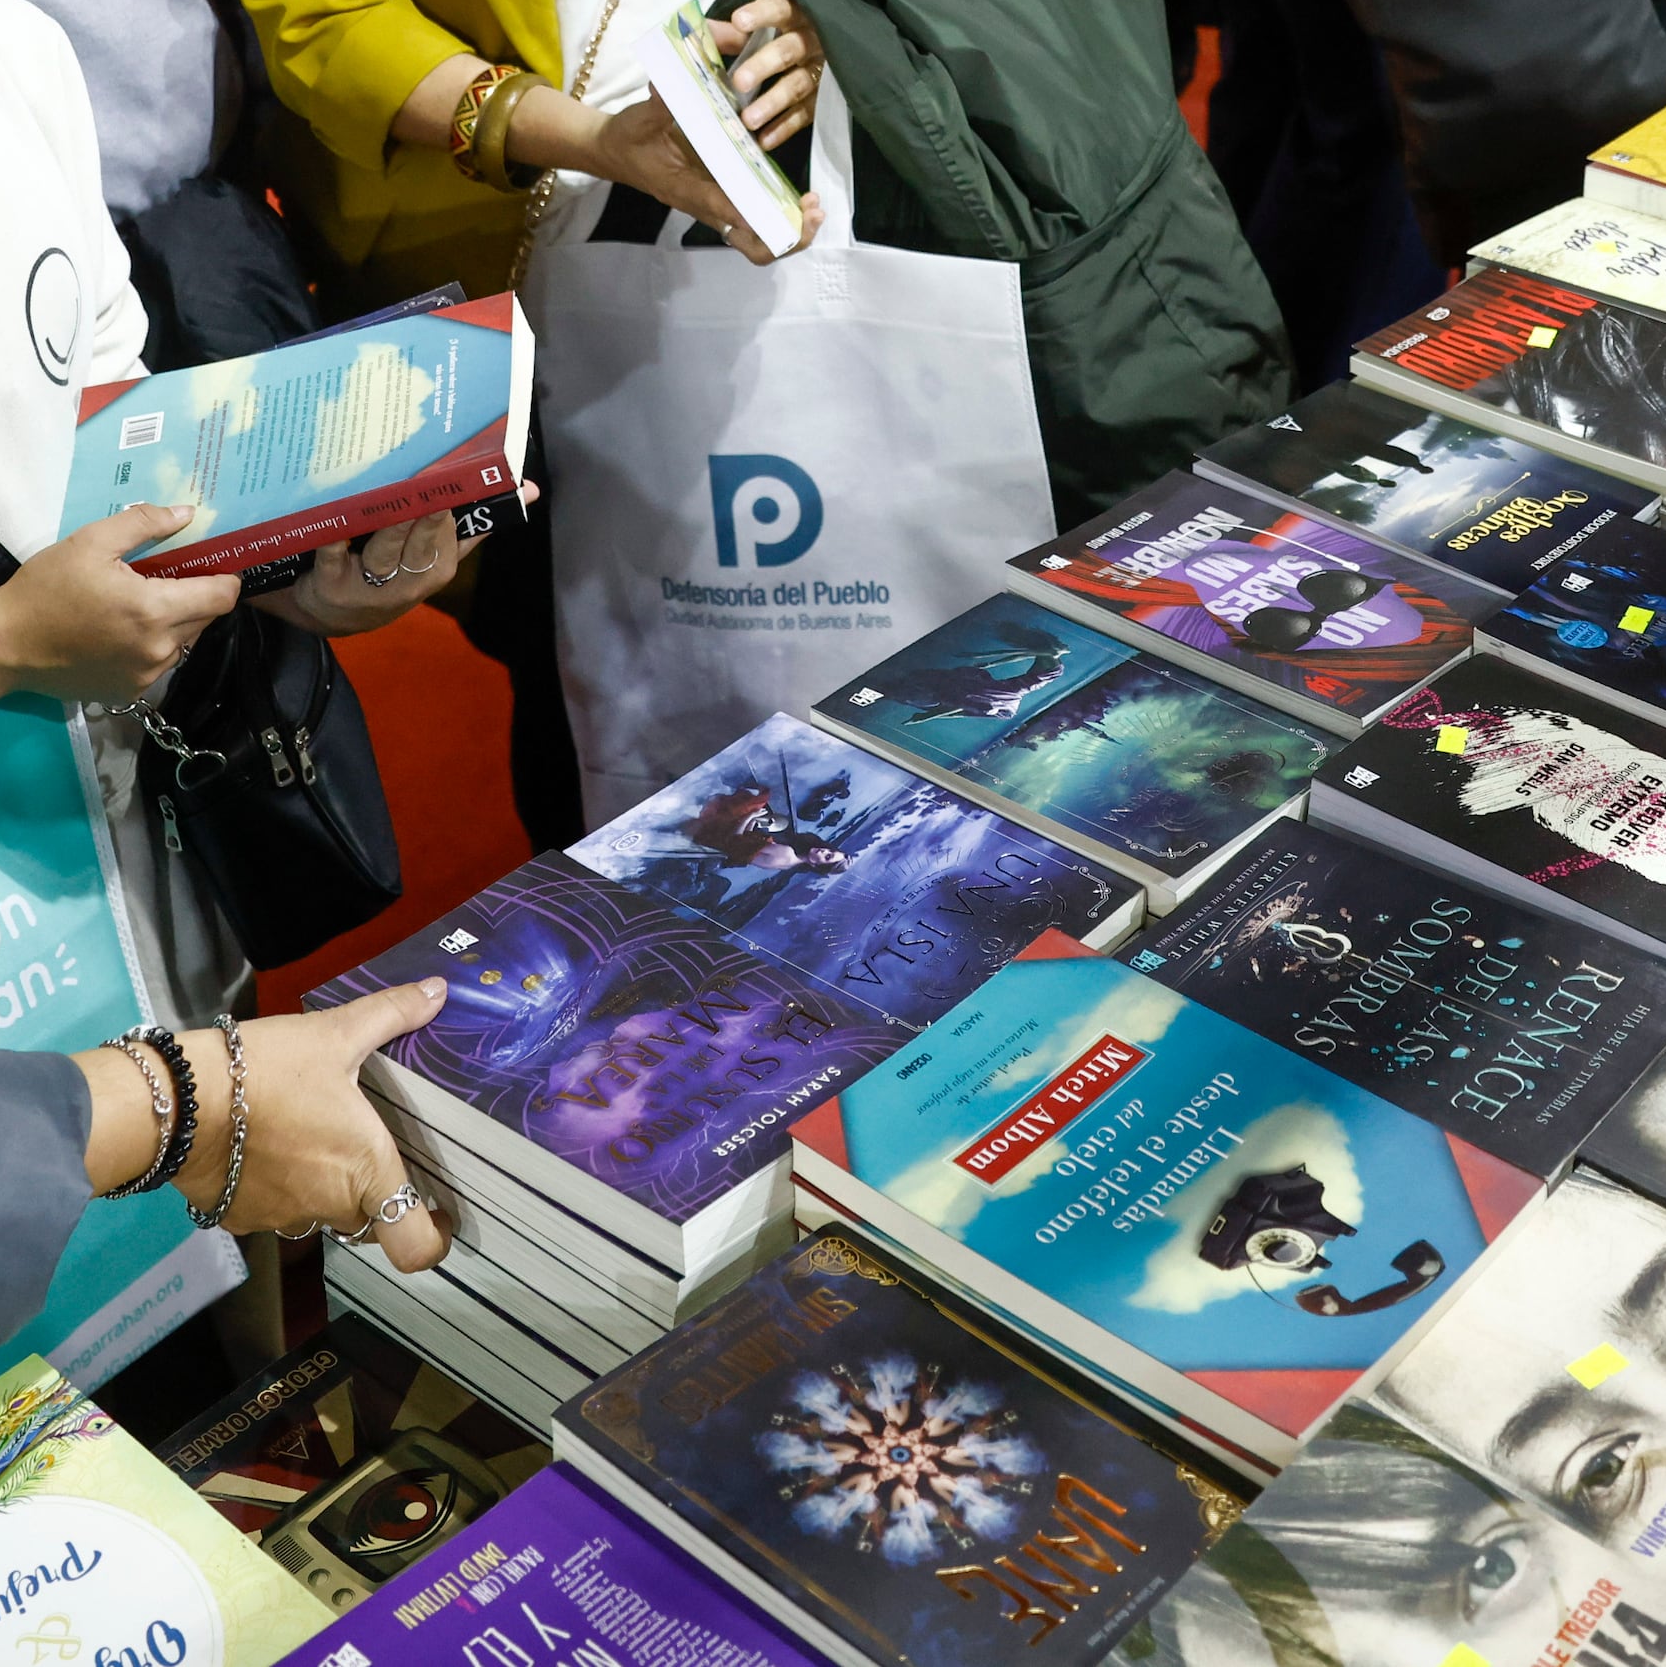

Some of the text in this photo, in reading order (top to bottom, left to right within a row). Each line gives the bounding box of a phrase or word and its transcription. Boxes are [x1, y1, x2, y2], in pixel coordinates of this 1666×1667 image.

[247, 532, 283, 553] desde
[283, 514, 349, 540] Llamadas
[1092, 506, 1246, 589] NOMBRE
[1446, 496, 1545, 553] Blancas
[1499, 488, 1590, 544] Noches
[661, 577, 890, 607] Defensoría del Pueblo
[1192, 552, 1250, 589] MI
[1203, 555, 1309, 625] SABES
[665, 609, 893, 631] Ciudad Autónoma de Buenos Aires
[1318, 605, 1391, 647] NO
[1515, 741, 1587, 797] DAN WELLS
[1590, 774, 1665, 835] EXTREMO
[955, 850, 1045, 919] UNA
[1169, 850, 1299, 961] KIERSTEN WHITE
[844, 910, 935, 989] ISLA
[1294, 897, 1474, 1057] SOMBRAS
[1465, 951, 1519, 1002] DE
[950, 1011, 985, 1037] MAEVA
[1397, 1001, 1476, 1062] LAS
[1450, 958, 1627, 1121] RENACE
[896, 1052, 933, 1080] OCEANO
[710, 1066, 844, 1160] SARAH TOLCSER
[966, 1043, 1133, 1174] Mitch Albom
[1054, 1099, 1144, 1178] del cielo
[1033, 1071, 1241, 1246] desde teléfono
[1110, 1124, 1247, 1236] Llamadas
[255, 1349, 340, 1414] GEORGE
[392, 1540, 510, 1631] DAVID LEVITHAN
[467, 1544, 547, 1608] RACHEL COHN
[935, 1471, 1147, 1647] JANE
[519, 1601, 570, 1651] Y
[1557, 1576, 1623, 1651] TRÉBOR
